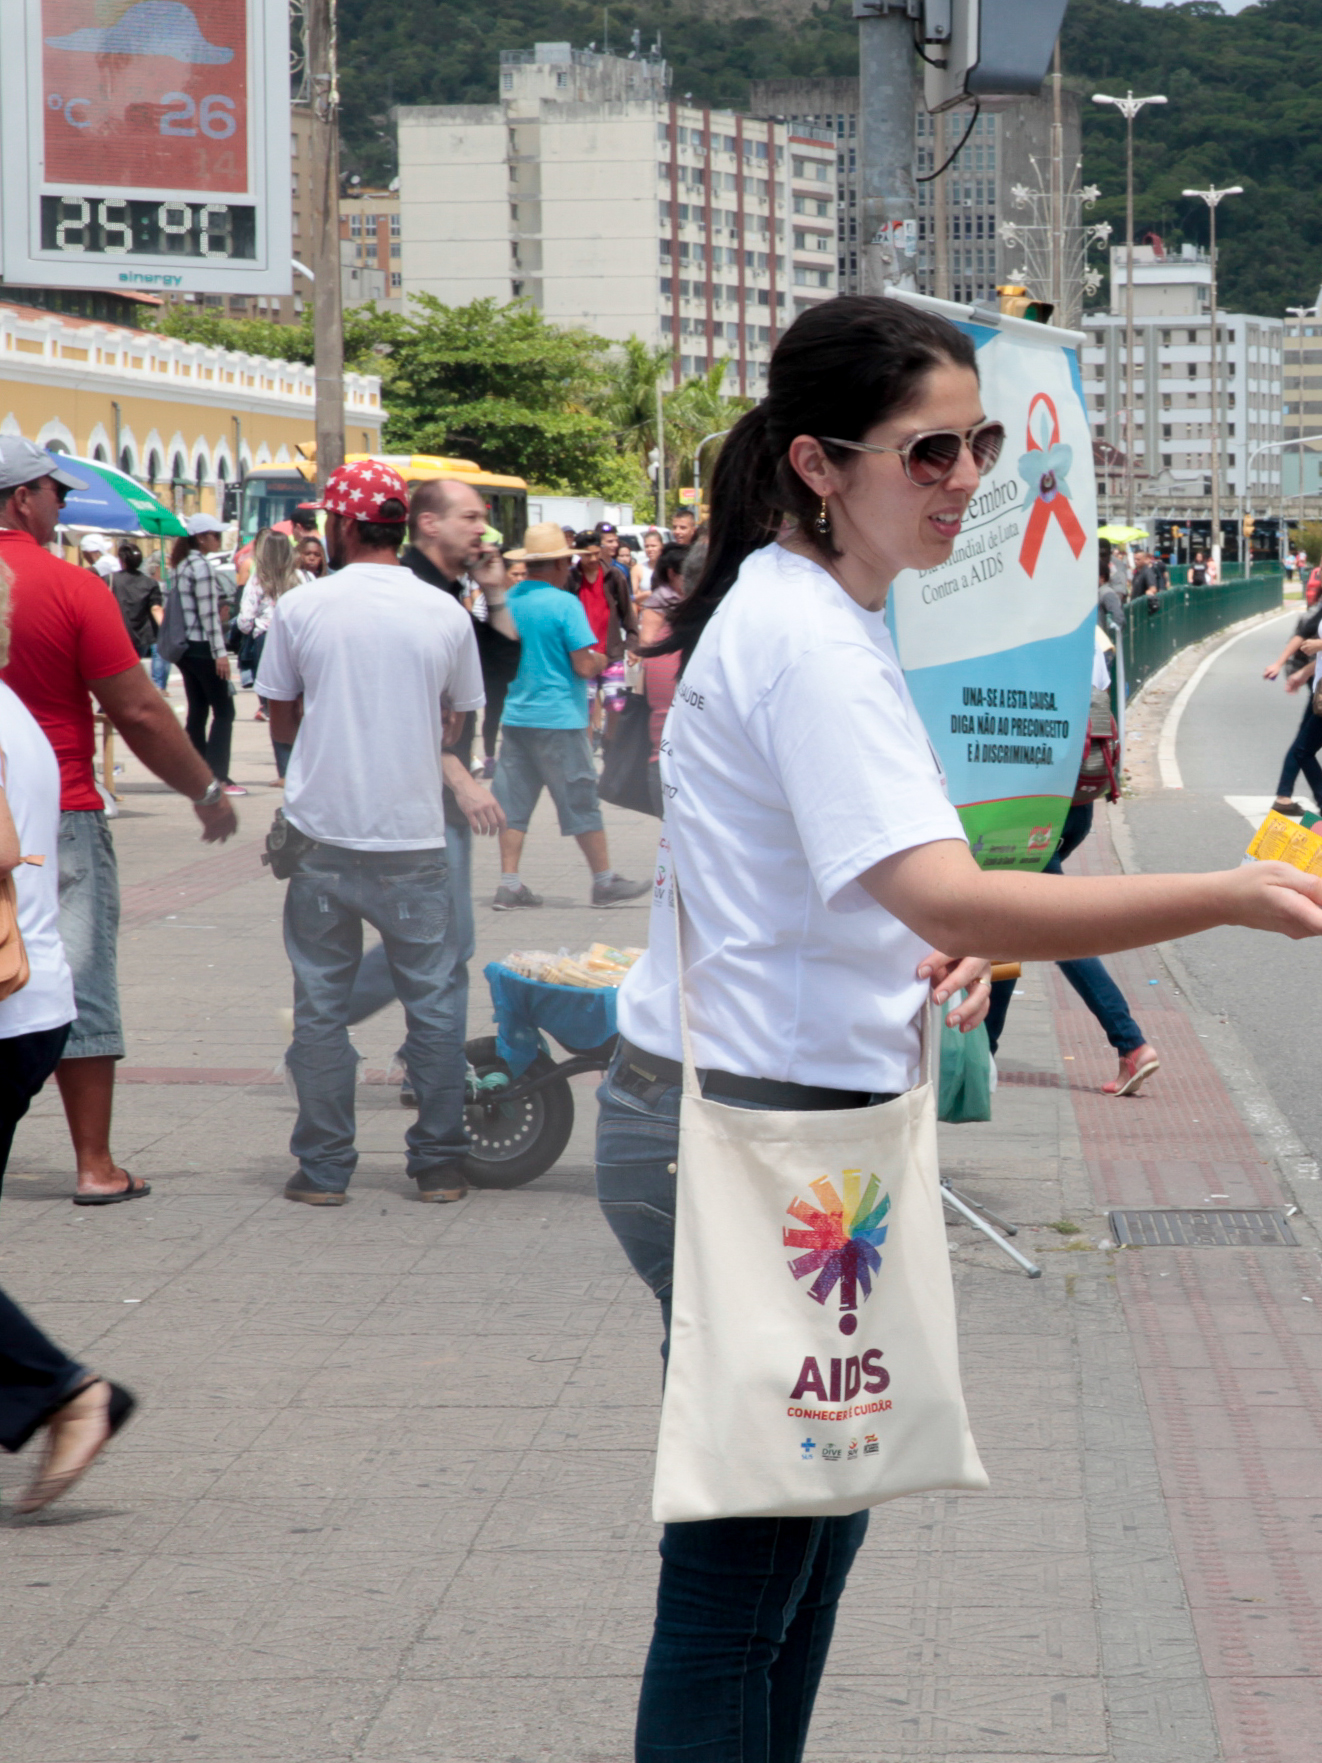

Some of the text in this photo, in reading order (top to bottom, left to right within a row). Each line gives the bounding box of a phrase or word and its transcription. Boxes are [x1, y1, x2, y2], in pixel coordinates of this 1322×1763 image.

[159, 91, 237, 140] 26
[118, 270, 183, 286] sinergy
[960, 479, 1018, 523] embro
[998, 522, 1020, 544] Luta
[921, 551, 1004, 605] Contra a AIDS
[962, 686, 1058, 711] UNA-SE A ESTA CAUSA.
[951, 712, 1069, 739] DIGA NÃO AO PRECONCEITO
[967, 743, 972, 762] E
[982, 743, 1054, 768] DISCRIMINAÇÃO.
[788, 1348, 891, 1403] AIDS
[787, 1406, 849, 1421] CONHECER
[854, 1399, 893, 1417] CUIDAR
[821, 1448, 842, 1456] DIVE
